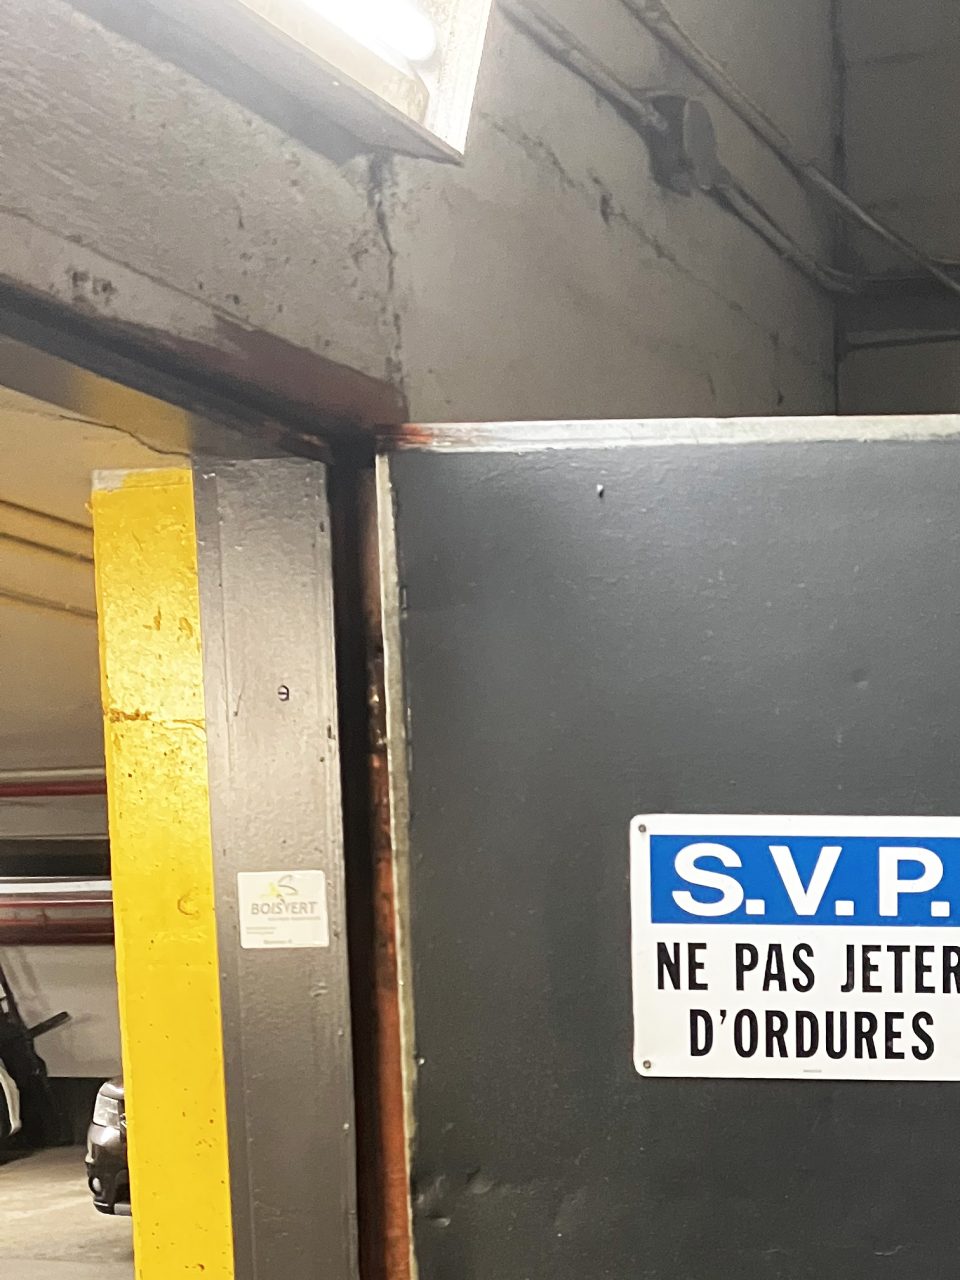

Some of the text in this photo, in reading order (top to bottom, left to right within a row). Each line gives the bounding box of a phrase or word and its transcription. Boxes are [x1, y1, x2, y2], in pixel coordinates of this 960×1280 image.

[671, 842, 951, 917] S.V.P.
[251, 902, 317, 915] BOISVERT
[656, 941, 709, 991] NE
[735, 942, 816, 993] PAS
[689, 1008, 936, 1061] D'ORDURES
